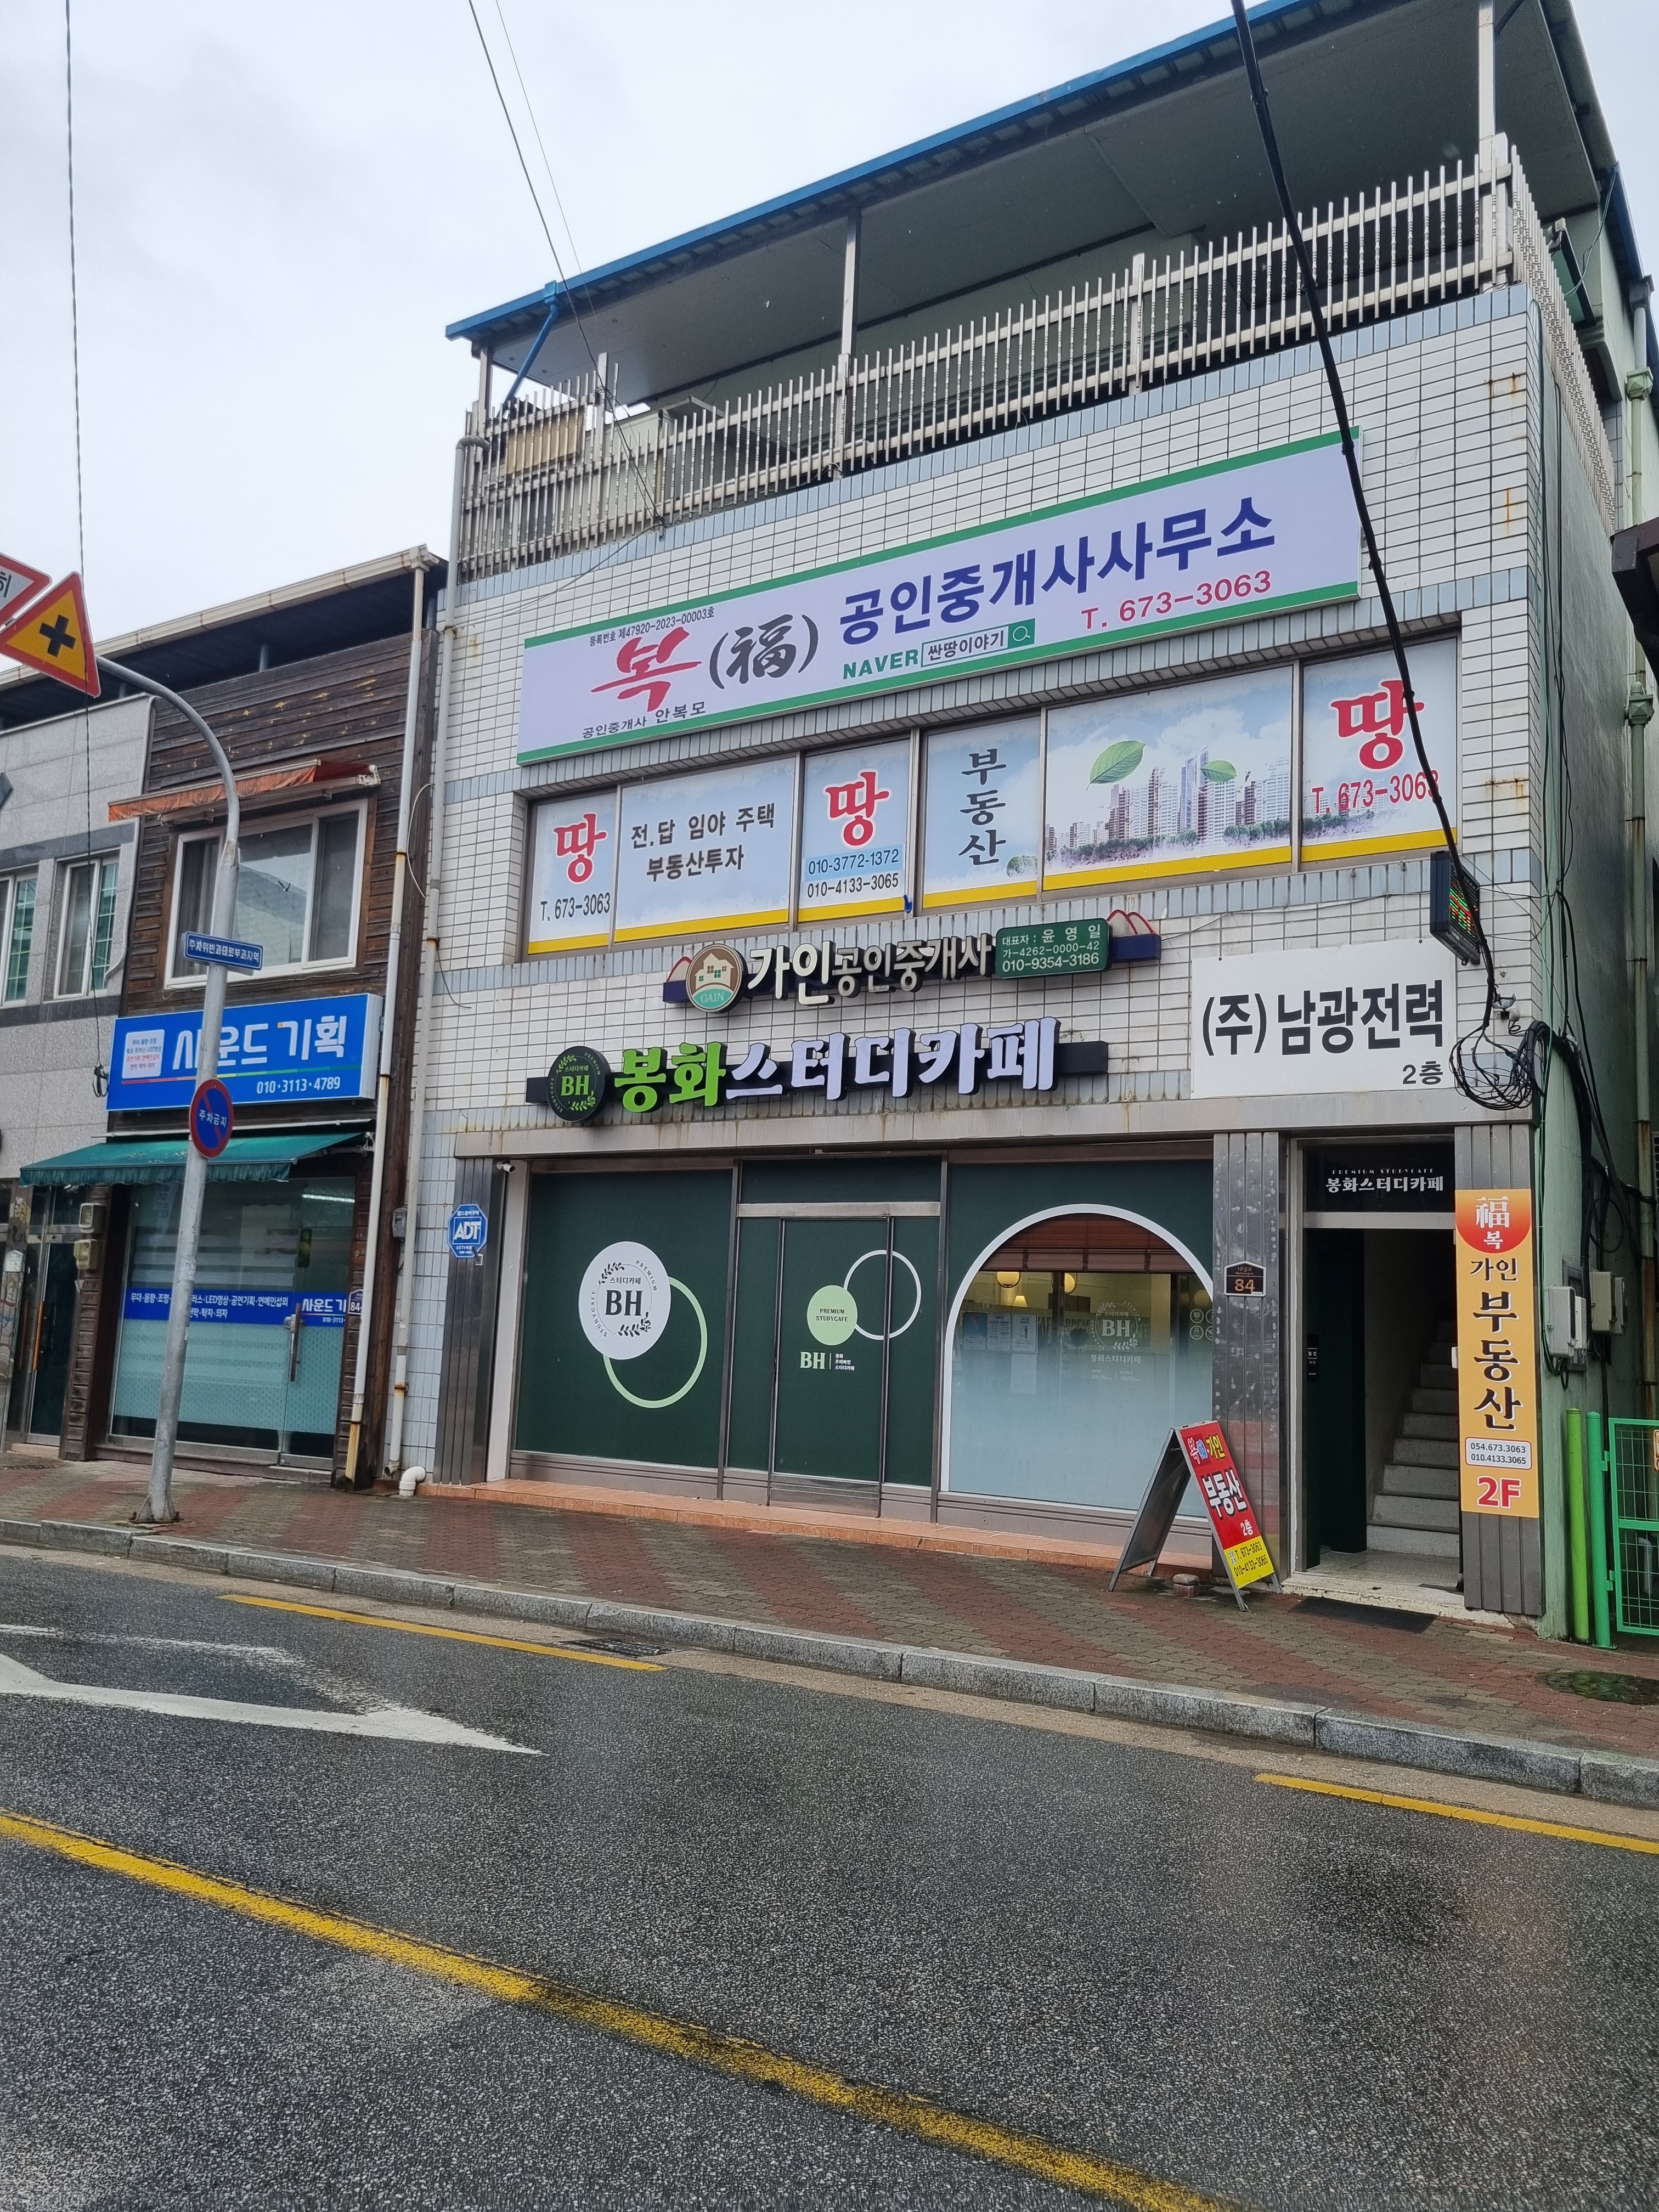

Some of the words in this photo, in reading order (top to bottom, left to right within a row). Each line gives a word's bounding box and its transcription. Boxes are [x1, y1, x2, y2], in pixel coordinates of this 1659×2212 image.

[839, 496, 1276, 646] 공인중개사사무소
[1120, 570, 1272, 622] 673-3063
[590, 631, 616, 647] 등록번호
[618, 606, 715, 639] 제47920-2023-00003호
[843, 648, 919, 680] NAVER
[928, 630, 1004, 662] 싼땅이야기
[582, 715, 647, 739] 공인중개사
[656, 701, 706, 723] 안복모
[1330, 679, 1425, 771] 땅
[824, 770, 891, 847] 땅
[958, 748, 1007, 866] 부동산
[631, 820, 675, 849] 전.답
[688, 811, 726, 839] 임야
[736, 803, 775, 831] 주택
[554, 814, 607, 883] 땅
[808, 848, 899, 876] 010-3772-1372
[646, 845, 744, 882] 부동산투자
[806, 872, 899, 899] 010-4133-3065
[555, 892, 611, 921] 673-3063
[1002, 952, 1099, 972] 010-9354-3186
[1003, 941, 1099, 958] 가-4262-0000-42
[701, 991, 725, 1003] GAIN
[278, 1015, 347, 1061] 기획
[561, 1075, 590, 1096] BH
[1402, 1060, 1443, 1085] 2층
[199, 1109, 227, 1128] 주차금지
[1325, 1176, 1443, 1193] 봉화스터디카페
[1476, 1195, 1510, 1228] 福
[454, 1221, 481, 1240] ADT
[1483, 1231, 1503, 1249] 복
[609, 1277, 641, 1285] 스터디카페
[636, 1260, 658, 1291] PREMIUM
[1470, 1257, 1518, 1282] 가인
[302, 1298, 334, 1312] 사운드
[605, 1290, 644, 1316] BH
[1102, 1319, 1130, 1337] BH
[800, 1351, 826, 1369] BH
[1090, 1354, 1141, 1364] 봉화스터디카페
[1472, 1290, 1523, 1431] 부동산
[1470, 1442, 1526, 1453] 054.673.3063
[1471, 1453, 1526, 1464] 010.4133.3065
[1201, 1468, 1248, 1519] 부동산
[1477, 1476, 1521, 1508] 2F
